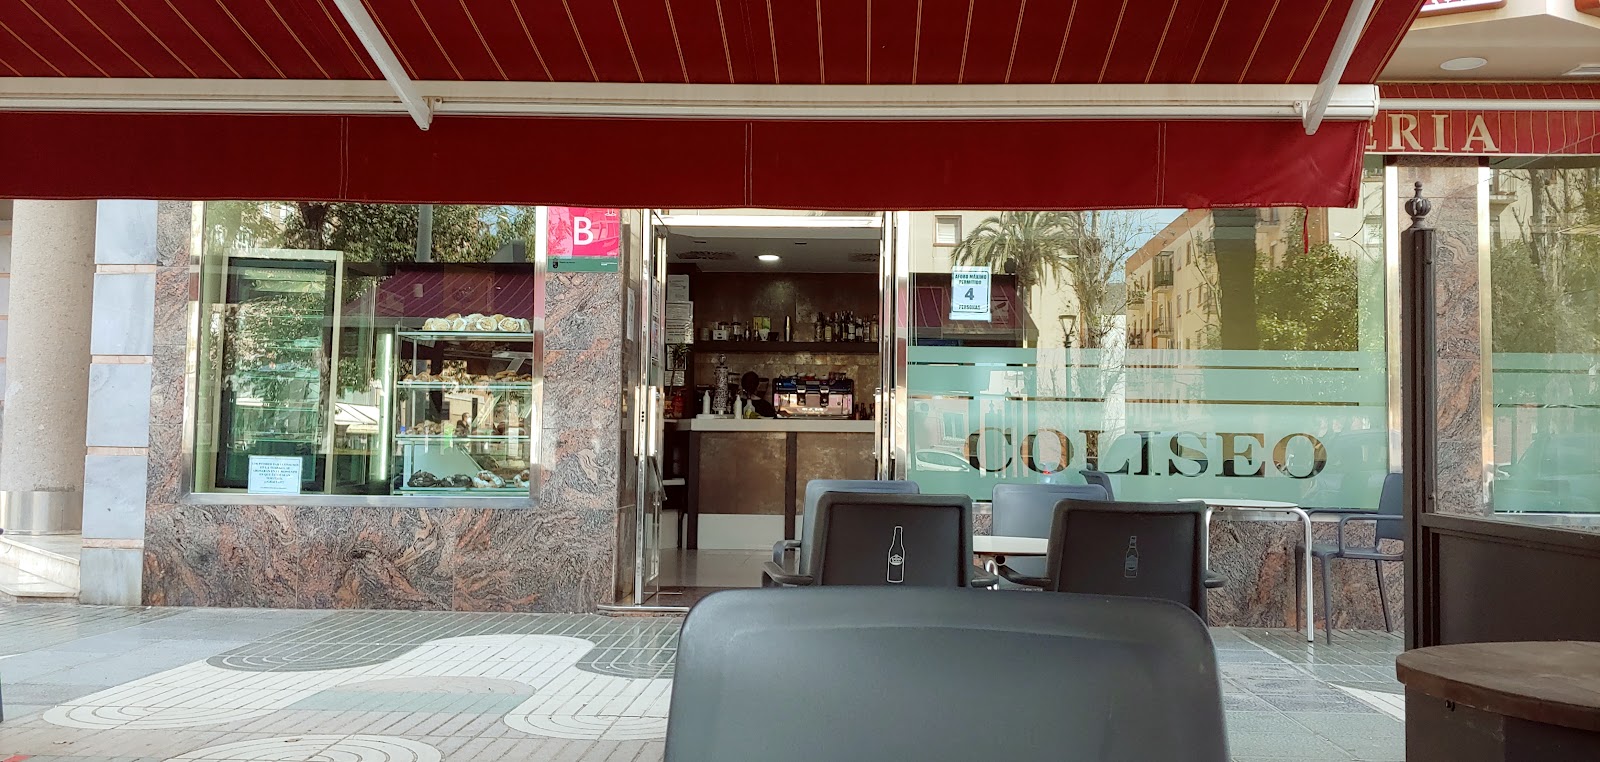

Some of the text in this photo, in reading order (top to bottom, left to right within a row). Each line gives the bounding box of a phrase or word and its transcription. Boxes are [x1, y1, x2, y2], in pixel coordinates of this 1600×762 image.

[573, 216, 594, 246] B
[964, 287, 975, 301] 4
[964, 427, 1328, 479] COLISEO
